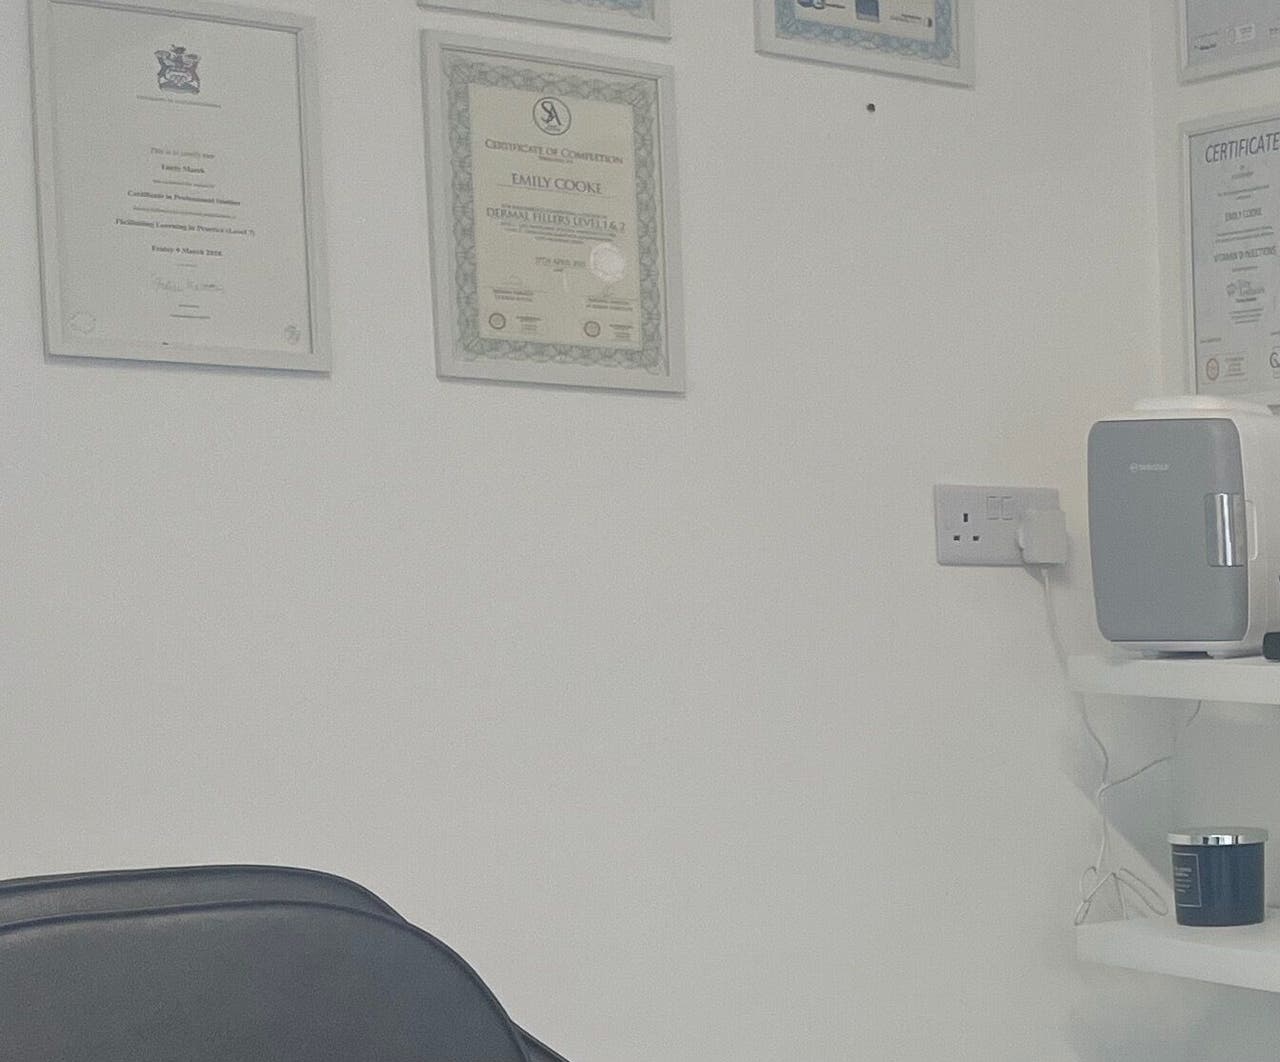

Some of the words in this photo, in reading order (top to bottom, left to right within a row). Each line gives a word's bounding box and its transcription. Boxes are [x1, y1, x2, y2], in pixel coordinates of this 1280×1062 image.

[1205, 132, 1280, 163] CERTIFICATE
[511, 172, 552, 189] EMILY
[554, 177, 603, 194] COOKE
